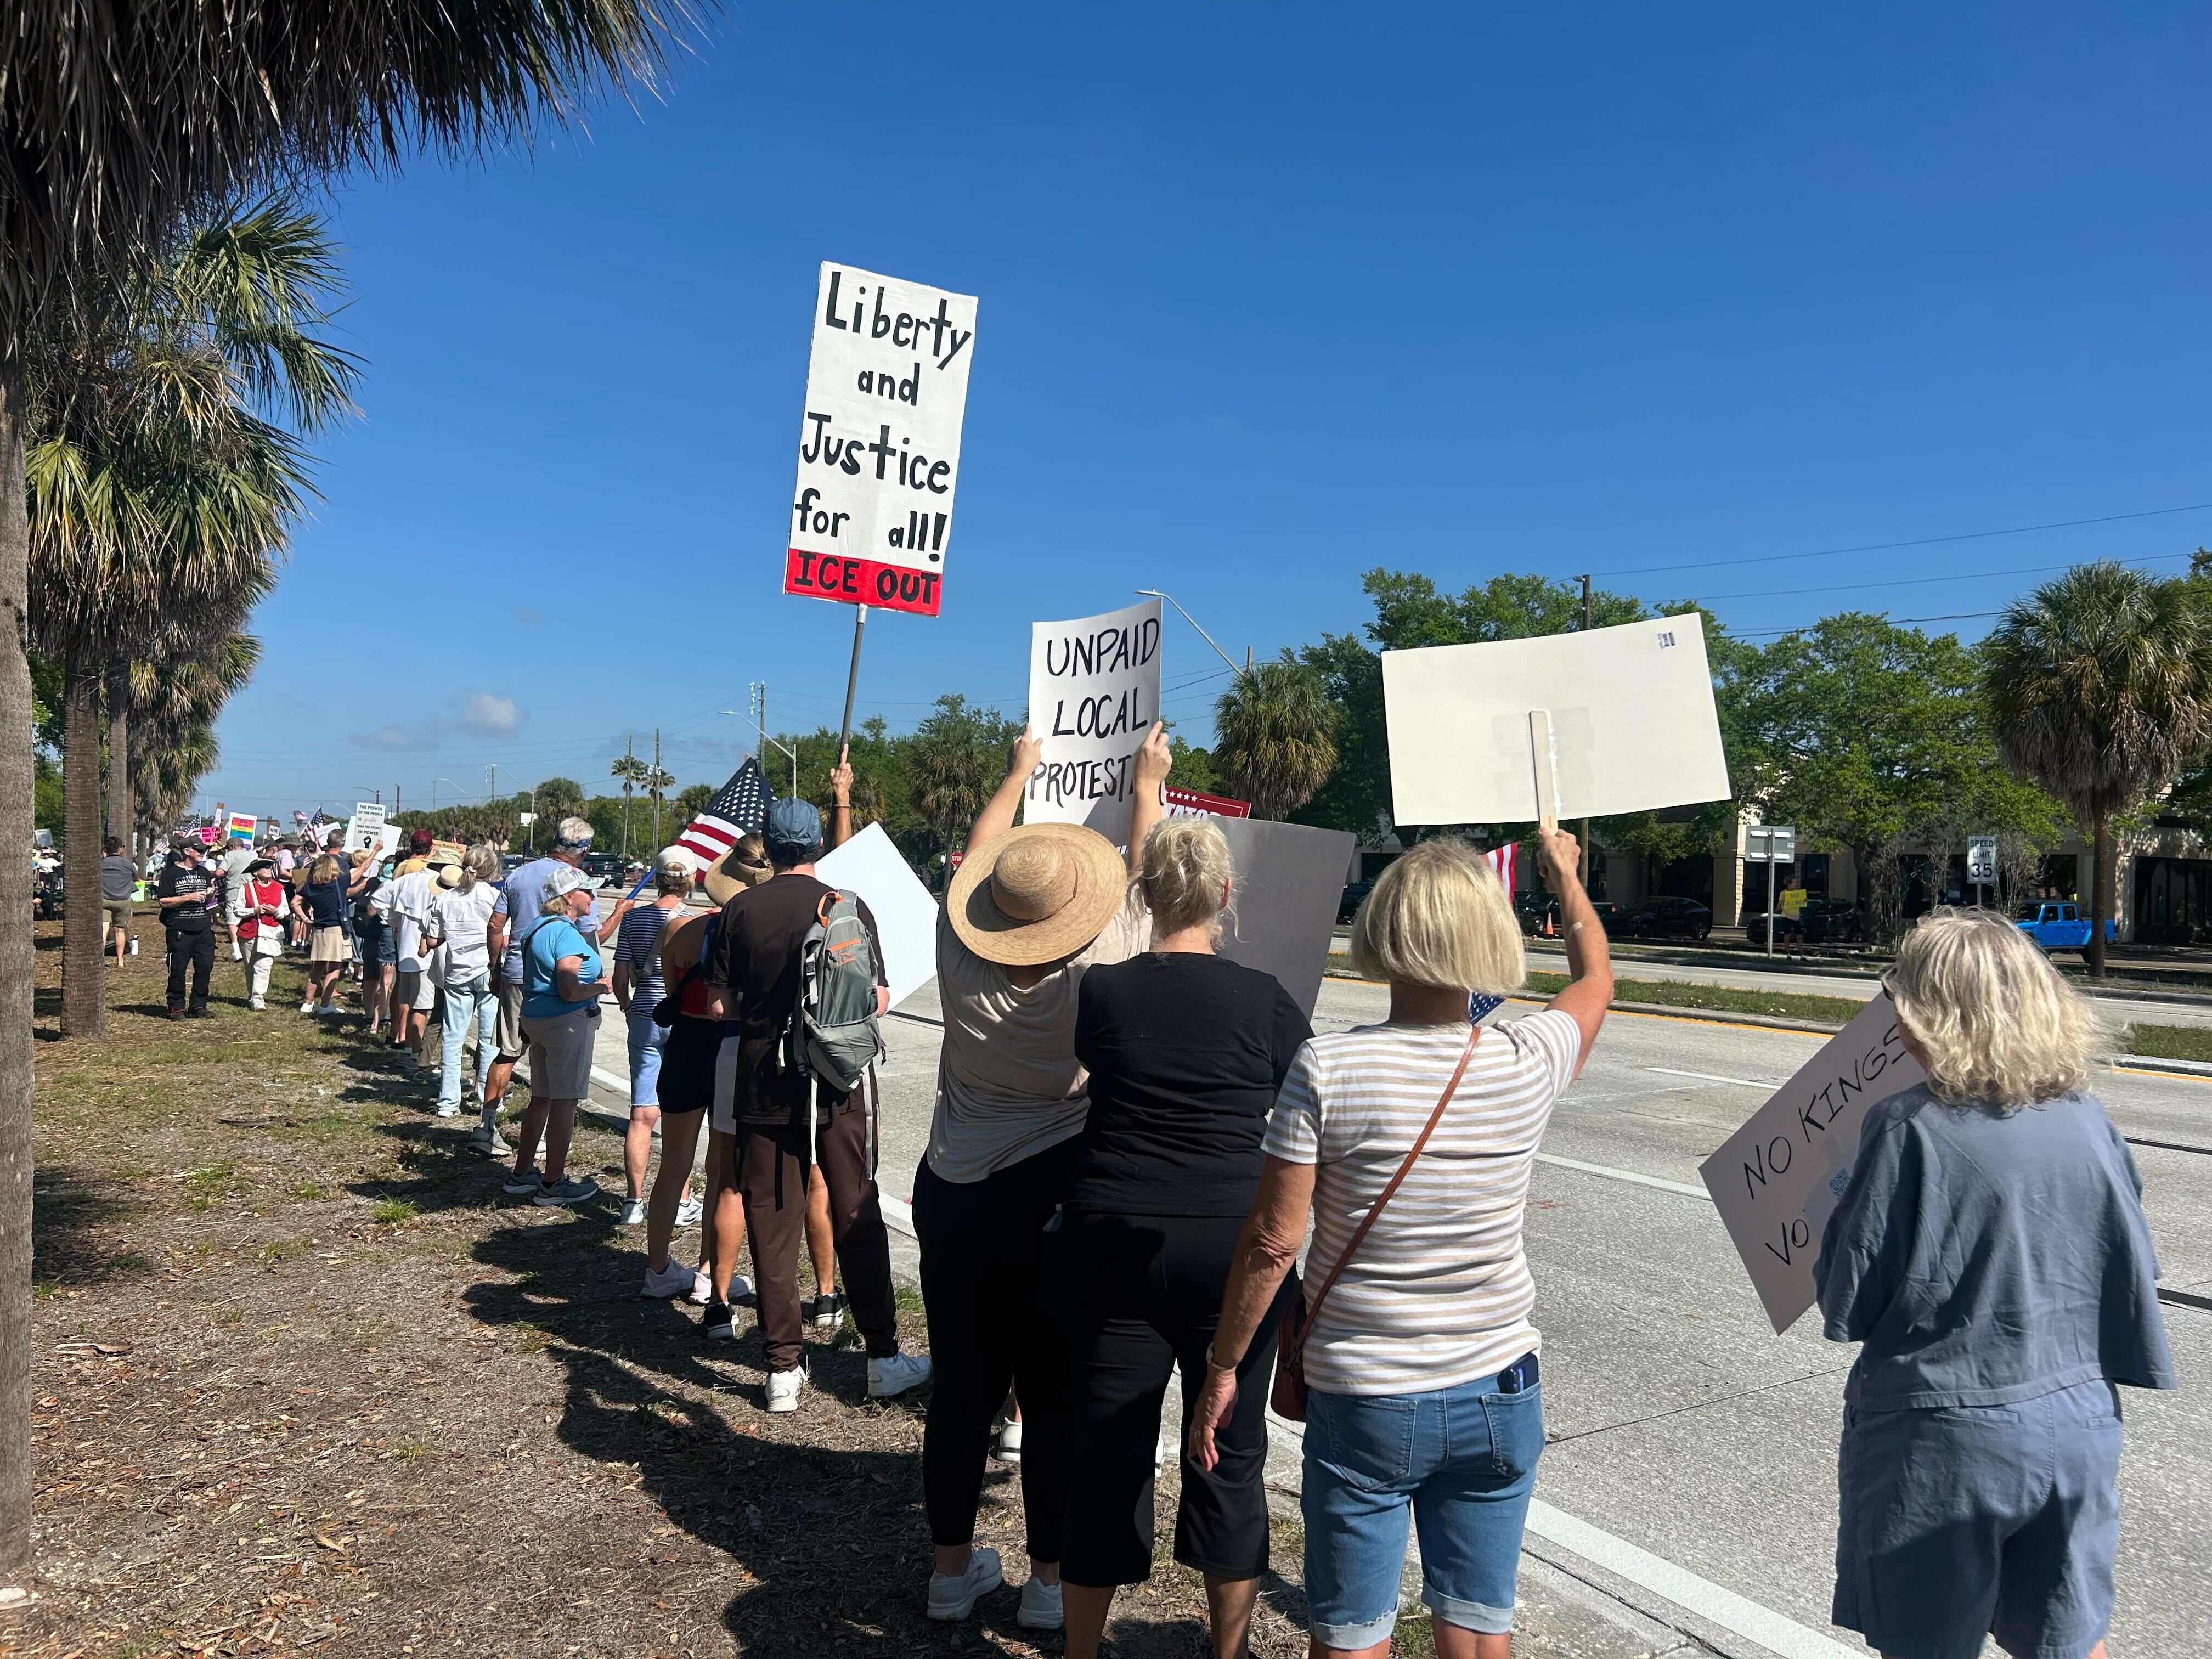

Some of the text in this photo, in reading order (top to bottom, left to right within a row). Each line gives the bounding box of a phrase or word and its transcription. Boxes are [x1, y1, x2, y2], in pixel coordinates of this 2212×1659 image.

[826, 271, 972, 370] Liberty
[858, 363, 920, 405] and
[802, 411, 950, 494] Justice
[795, 488, 947, 562] for all!
[794, 551, 939, 604] ICE OUT
[1047, 618, 1159, 676] UNPAID
[1052, 687, 1147, 739] LOCAL
[1030, 754, 1164, 808] PROTEST
[1971, 862, 1993, 877] 35
[1744, 1136, 1791, 1200] NO
